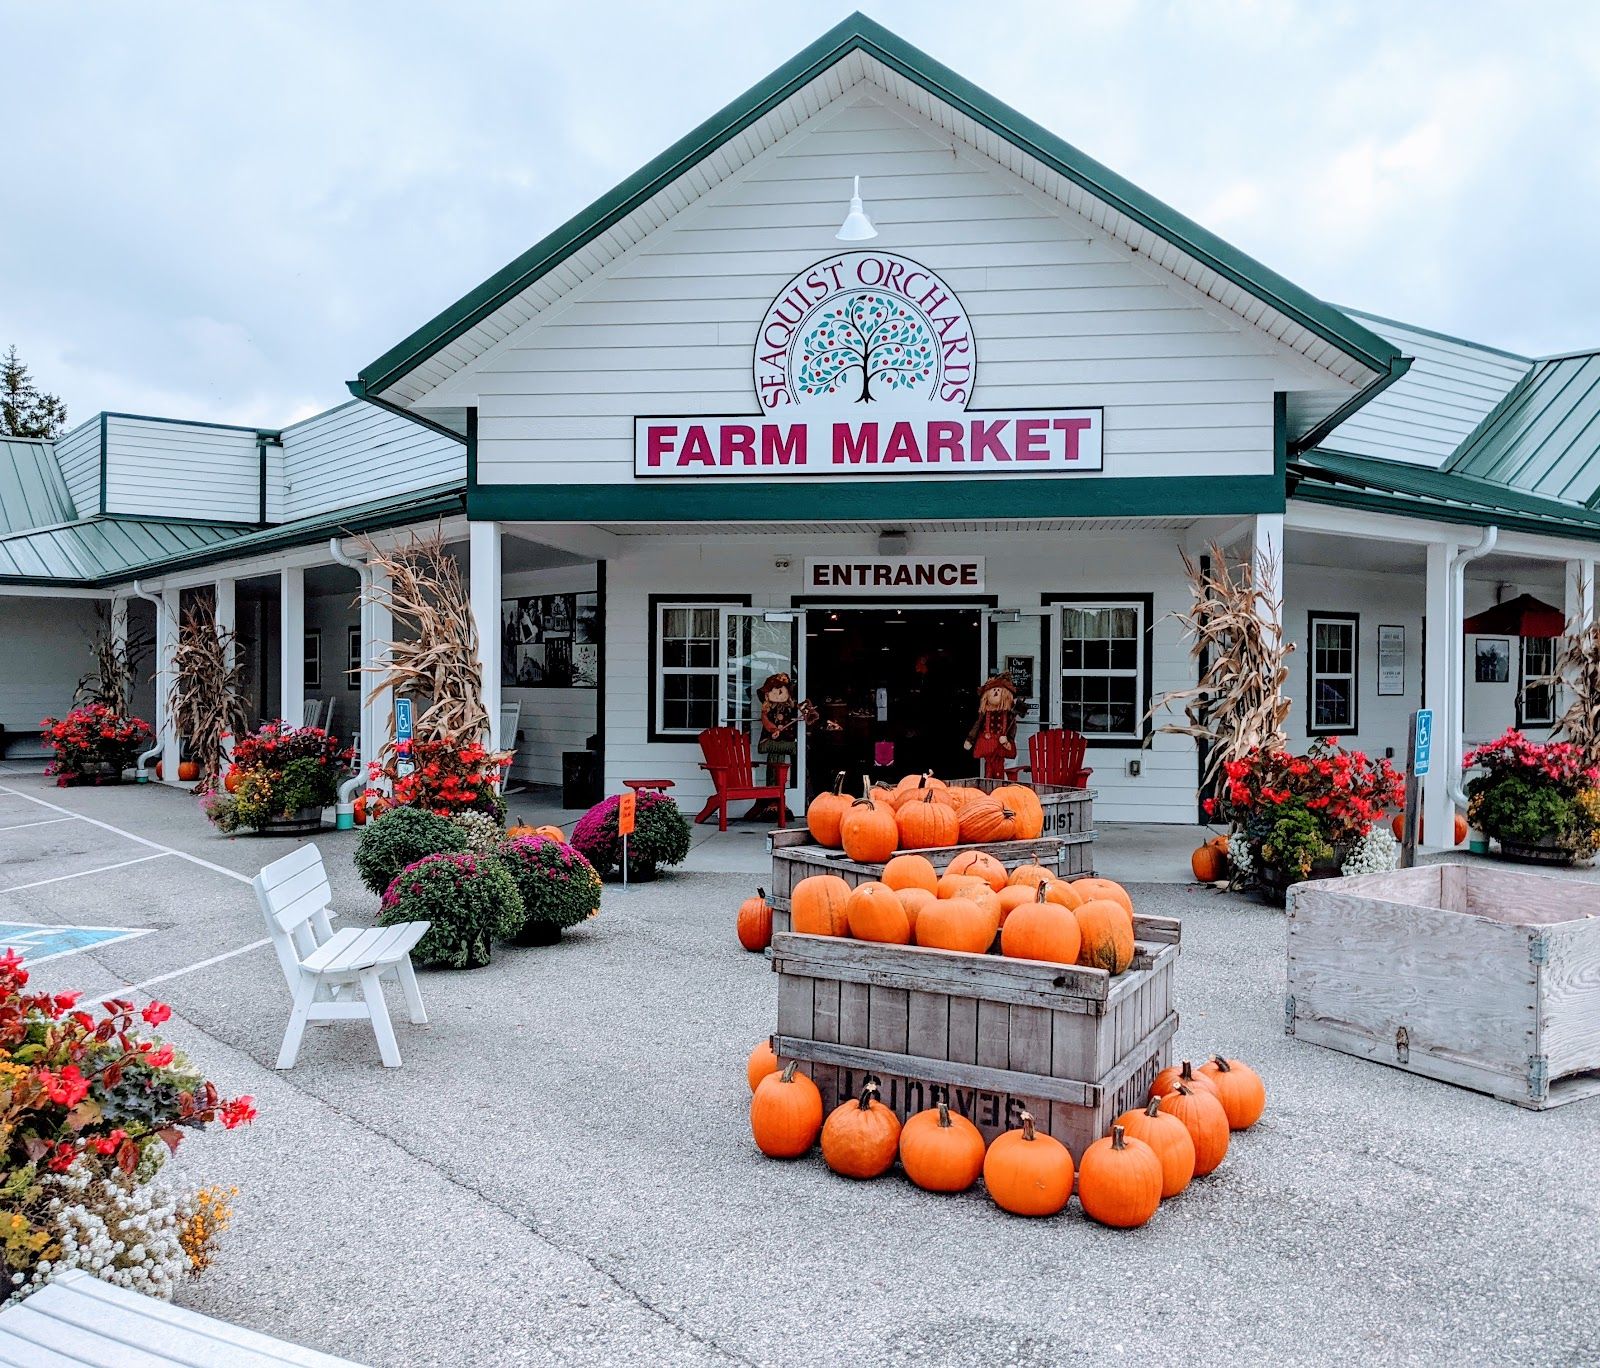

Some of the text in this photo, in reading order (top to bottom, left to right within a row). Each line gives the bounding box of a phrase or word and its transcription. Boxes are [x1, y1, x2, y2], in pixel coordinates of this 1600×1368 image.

[759, 257, 970, 409] SEAQUIST ORCHARDS
[647, 417, 1092, 467] FARM MARKET
[813, 563, 978, 586] ENTRANCE
[1043, 812, 1075, 831] UIST
